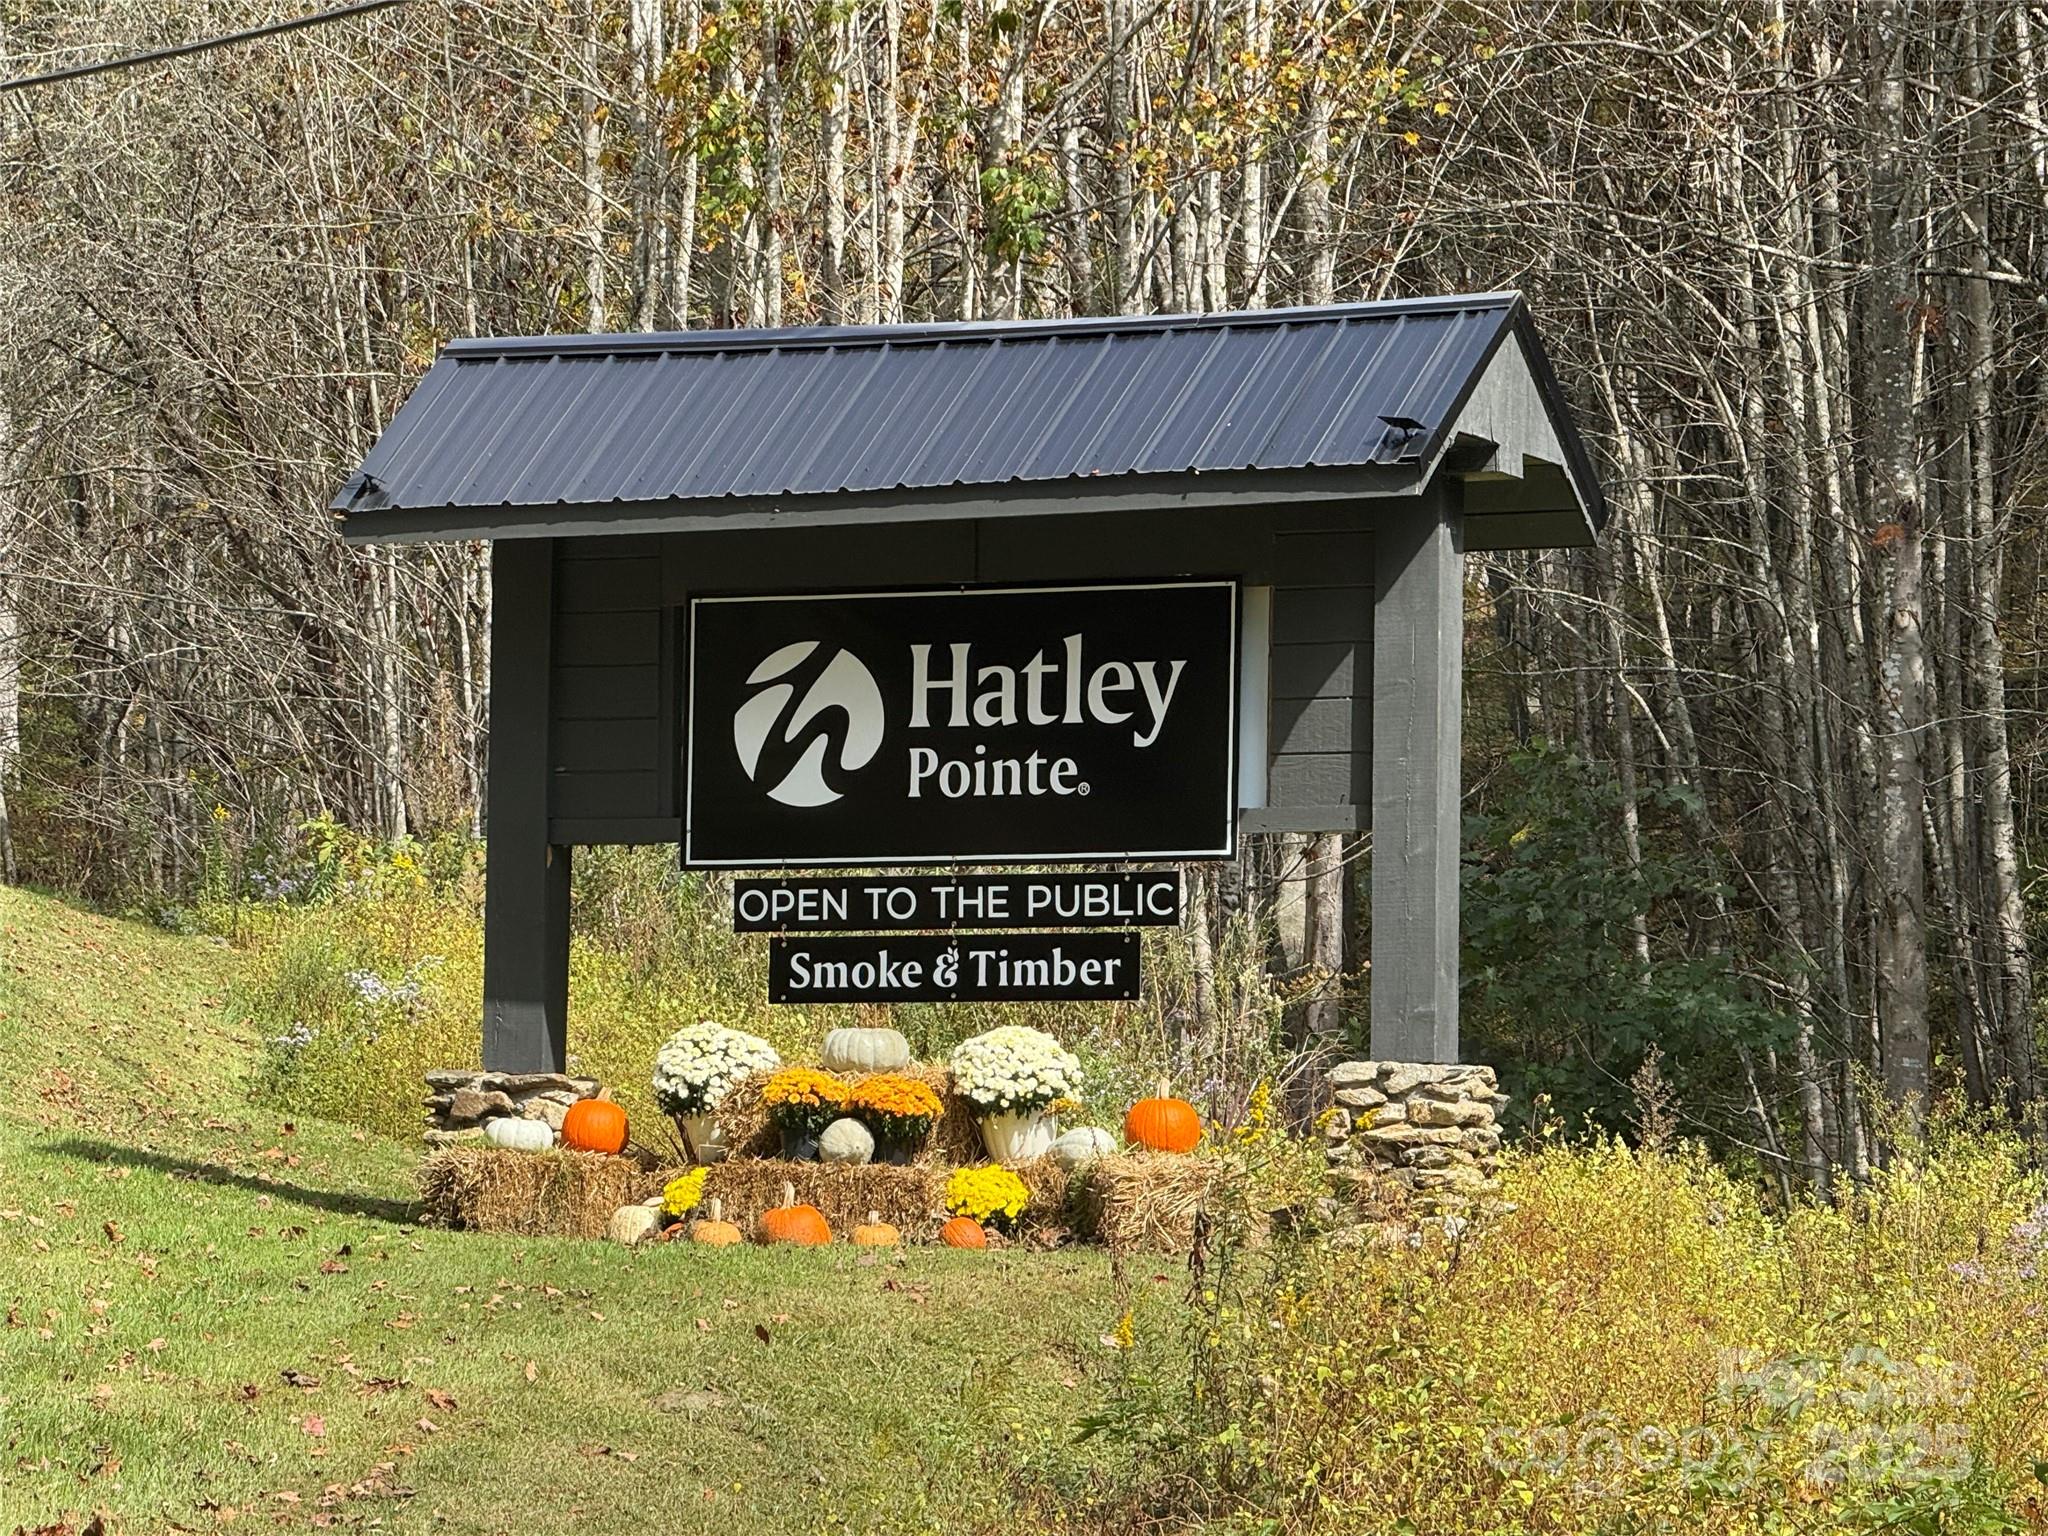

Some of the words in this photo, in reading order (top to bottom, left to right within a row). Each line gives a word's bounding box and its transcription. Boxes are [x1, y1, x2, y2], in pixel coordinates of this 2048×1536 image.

[908, 633, 1187, 748] Hatley
[738, 888, 848, 922] OPEN
[863, 886, 917, 920] TO
[930, 885, 1010, 919] THE
[1027, 882, 1174, 918] PUBLIC
[789, 949, 923, 989] Smoke
[932, 946, 960, 988] &
[969, 947, 1122, 987] Timber
